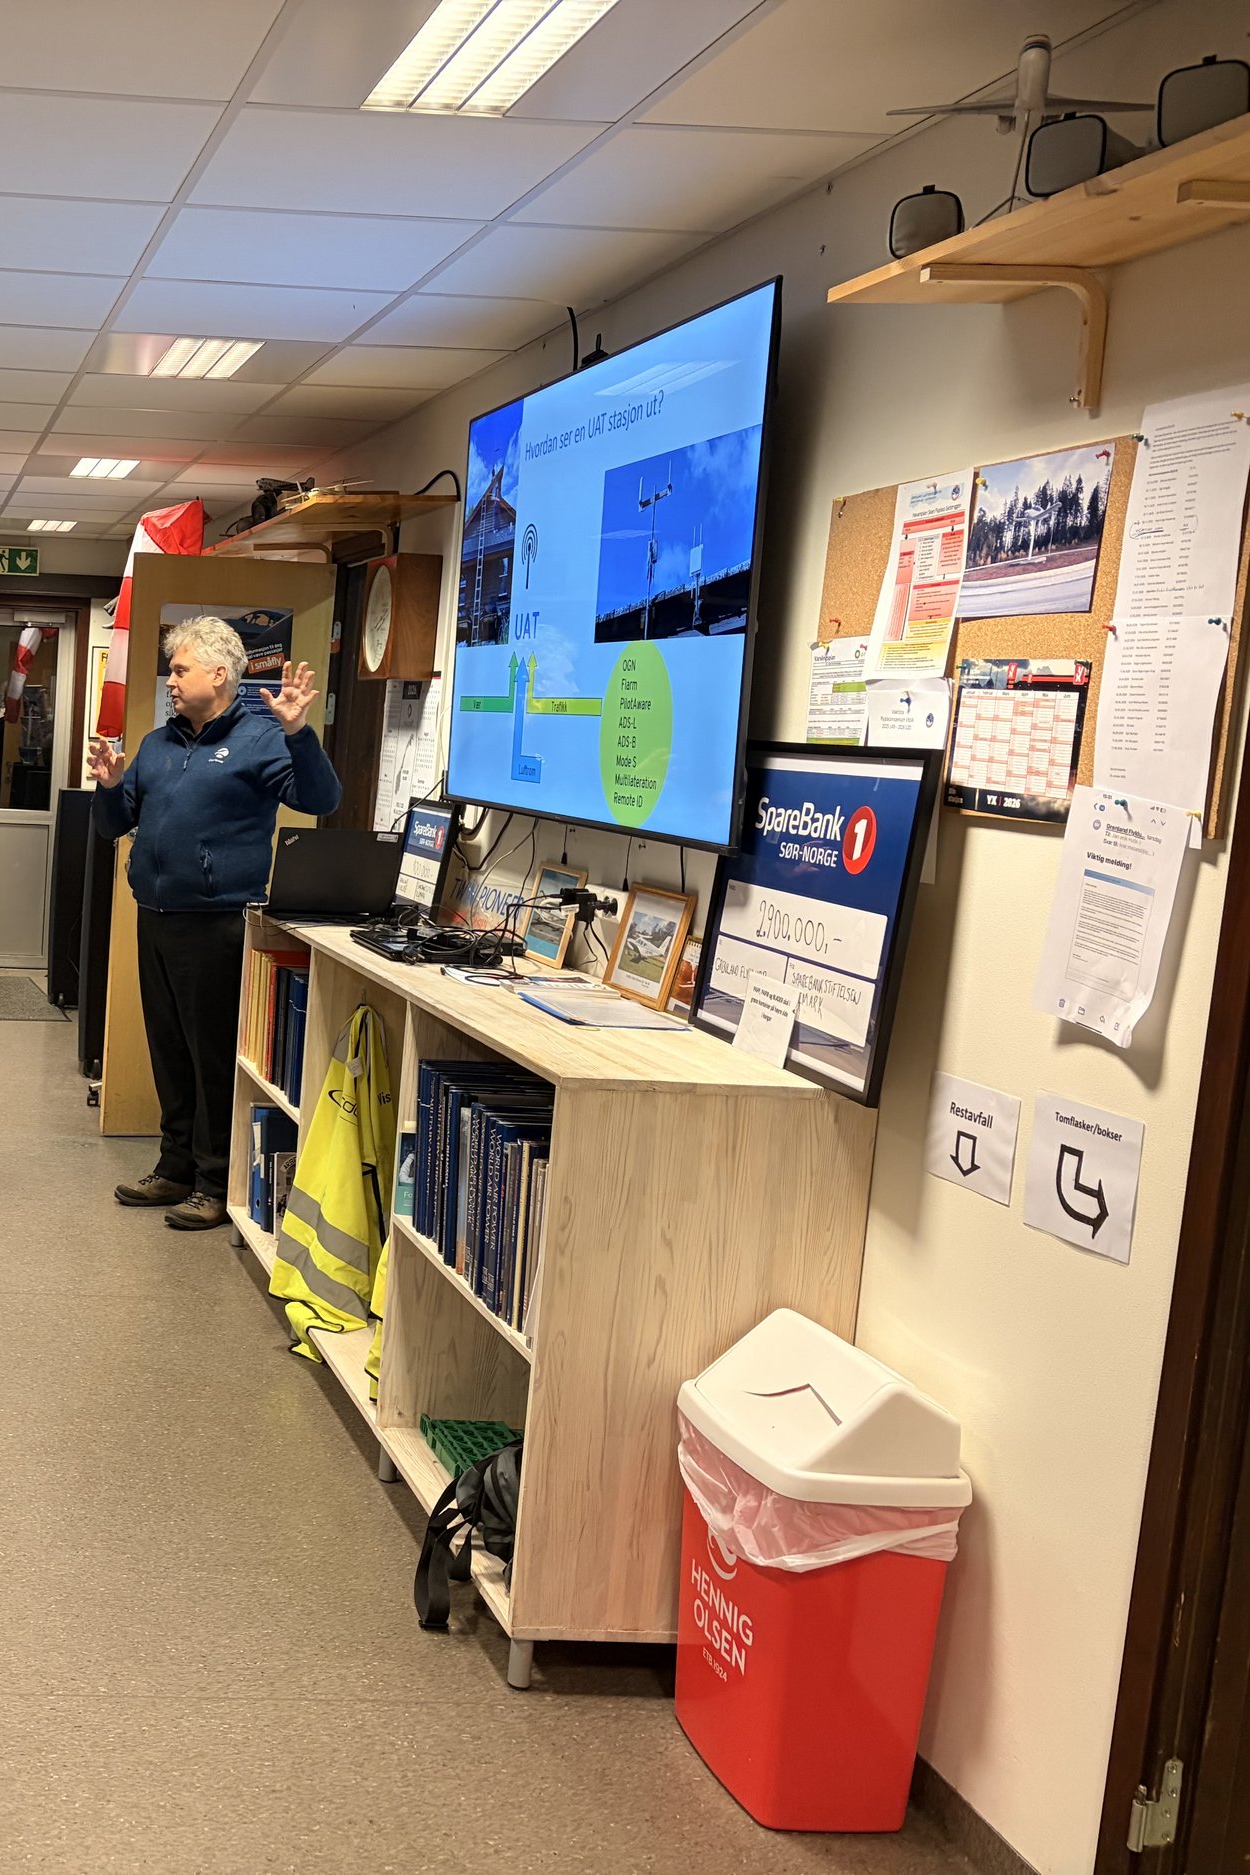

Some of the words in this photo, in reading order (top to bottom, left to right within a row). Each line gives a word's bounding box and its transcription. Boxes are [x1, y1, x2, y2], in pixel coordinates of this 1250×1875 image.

[525, 434, 558, 461] Hvordan
[559, 429, 573, 448] ser
[574, 427, 586, 442] en
[588, 412, 607, 439] UAT
[608, 404, 643, 434] stasjon
[646, 390, 664, 418] ut?
[515, 611, 540, 640] UAT
[251, 662, 254, 670] i
[254, 656, 282, 670] småfly
[622, 659, 636, 672] OGN
[621, 679, 638, 691] Flarm
[620, 697, 651, 710] PilotAware
[619, 717, 637, 730] ADS-L
[617, 735, 636, 748] ADS-B
[616, 755, 629, 768] Mode
[631, 756, 637, 768] S
[615, 774, 657, 790] Multilateration
[613, 792, 634, 807] Remote
[636, 794, 643, 808] ID
[1003, 797, 1021, 809] 2026
[414, 821, 437, 838] SpareBank
[755, 797, 844, 840] SpareBank
[779, 842, 839, 867] SØR-NORGE
[1086, 851, 1105, 863] Viktig
[1105, 857, 1132, 870] melding!
[450, 878, 479, 905] TWIN
[949, 1101, 994, 1129] Restavfall
[1055, 1111, 1123, 1142] Tomflasker/bokser
[488, 1129, 496, 1175] WORLD
[494, 1134, 502, 1181] WORLD
[484, 1198, 492, 1243] POWER
[490, 1204, 498, 1250] POWER
[691, 1559, 753, 1646] HENNIG
[694, 1598, 746, 1676] OLSEN
